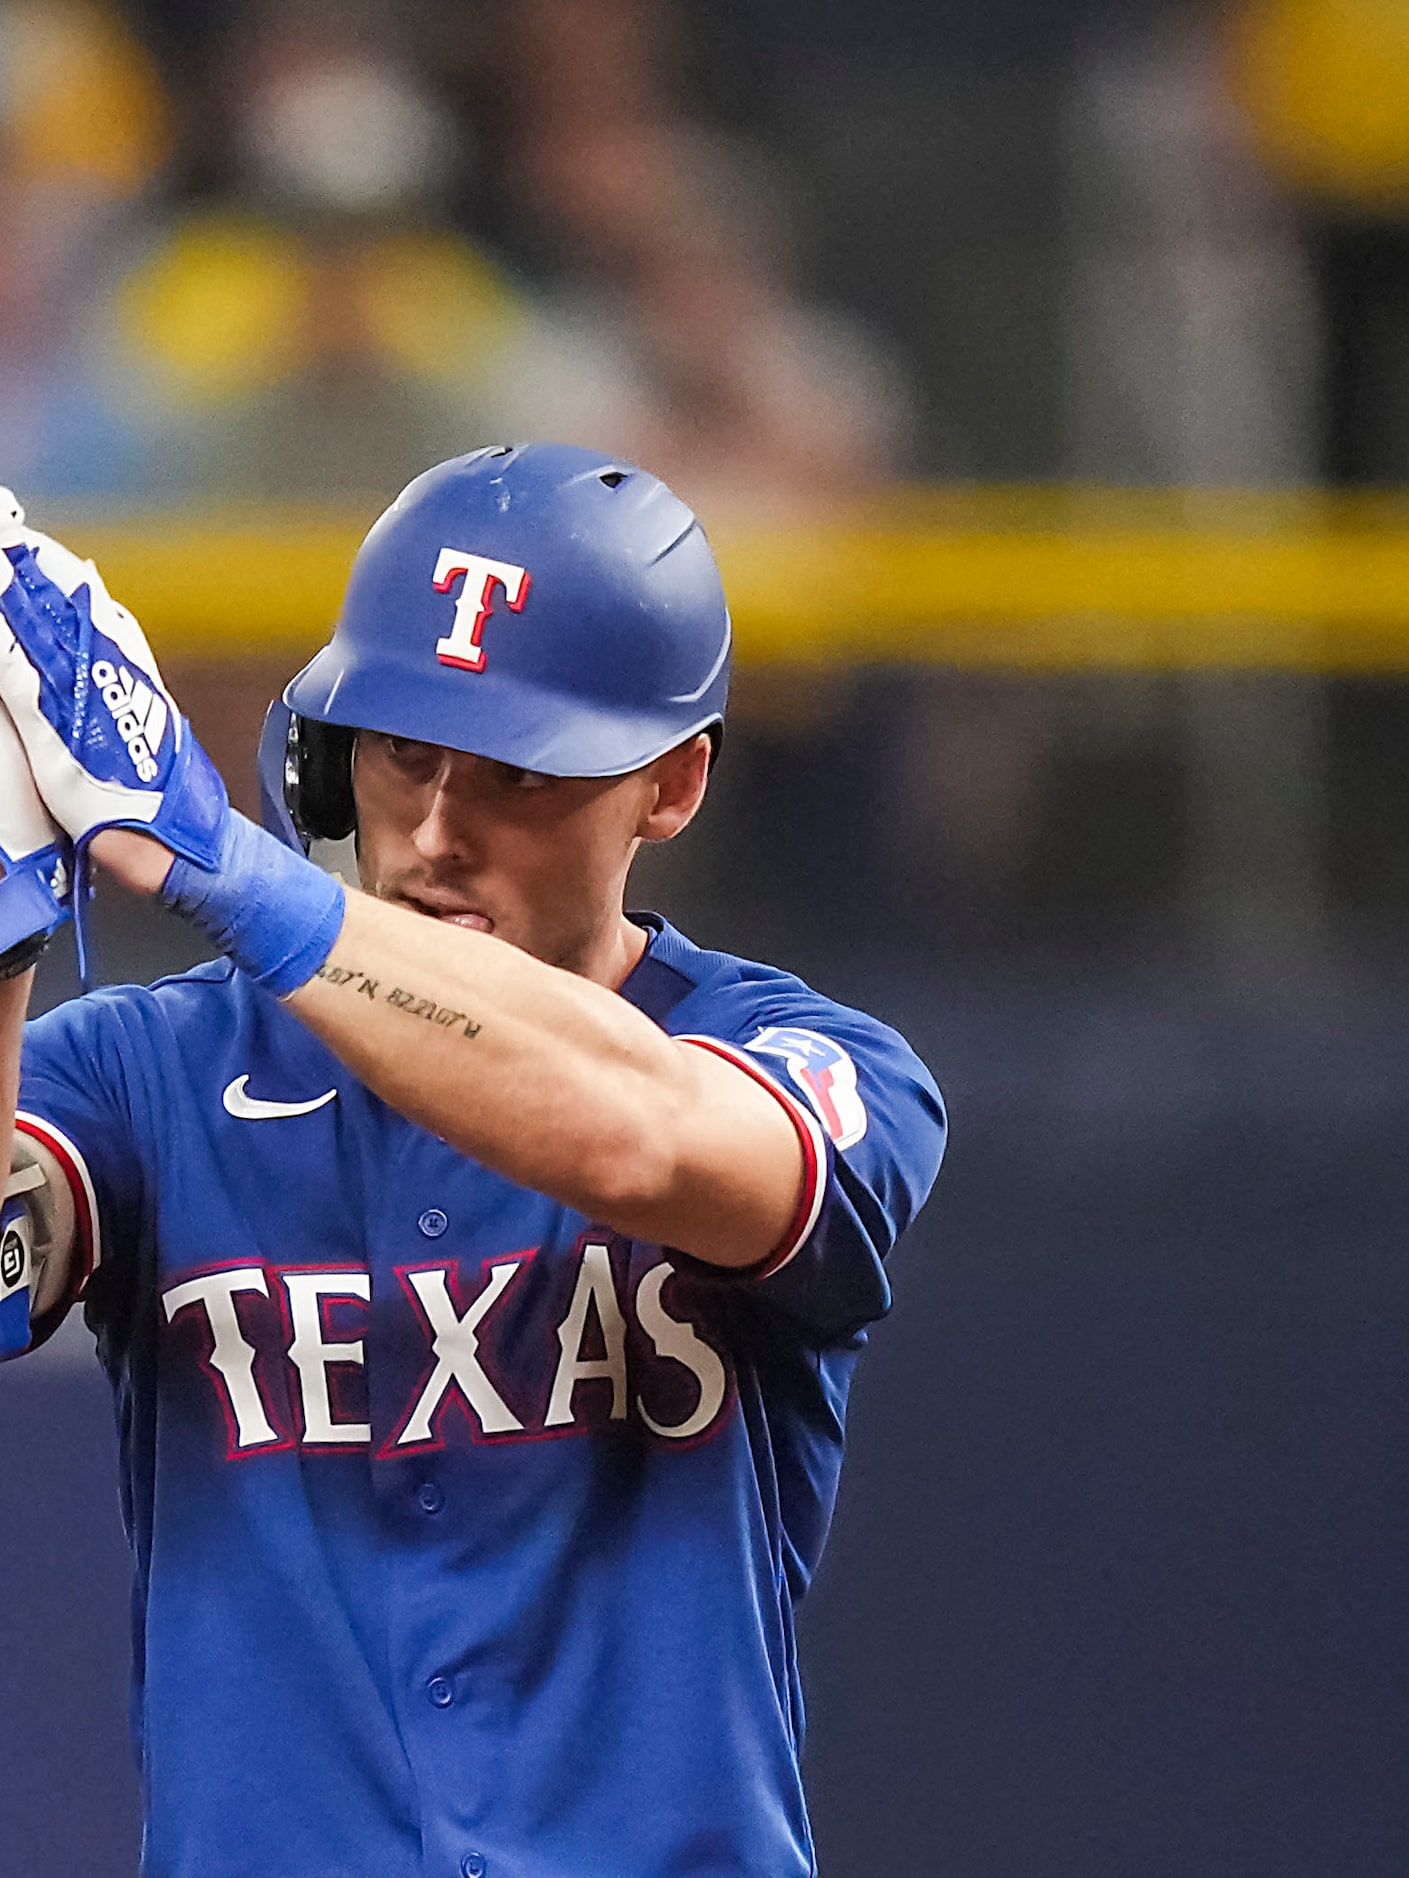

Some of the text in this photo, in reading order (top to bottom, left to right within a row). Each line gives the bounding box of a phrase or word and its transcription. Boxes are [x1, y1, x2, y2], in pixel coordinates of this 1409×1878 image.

[432, 547, 532, 674] T
[91, 660, 159, 783] adidas
[159, 1238, 732, 1454] TEXAS
